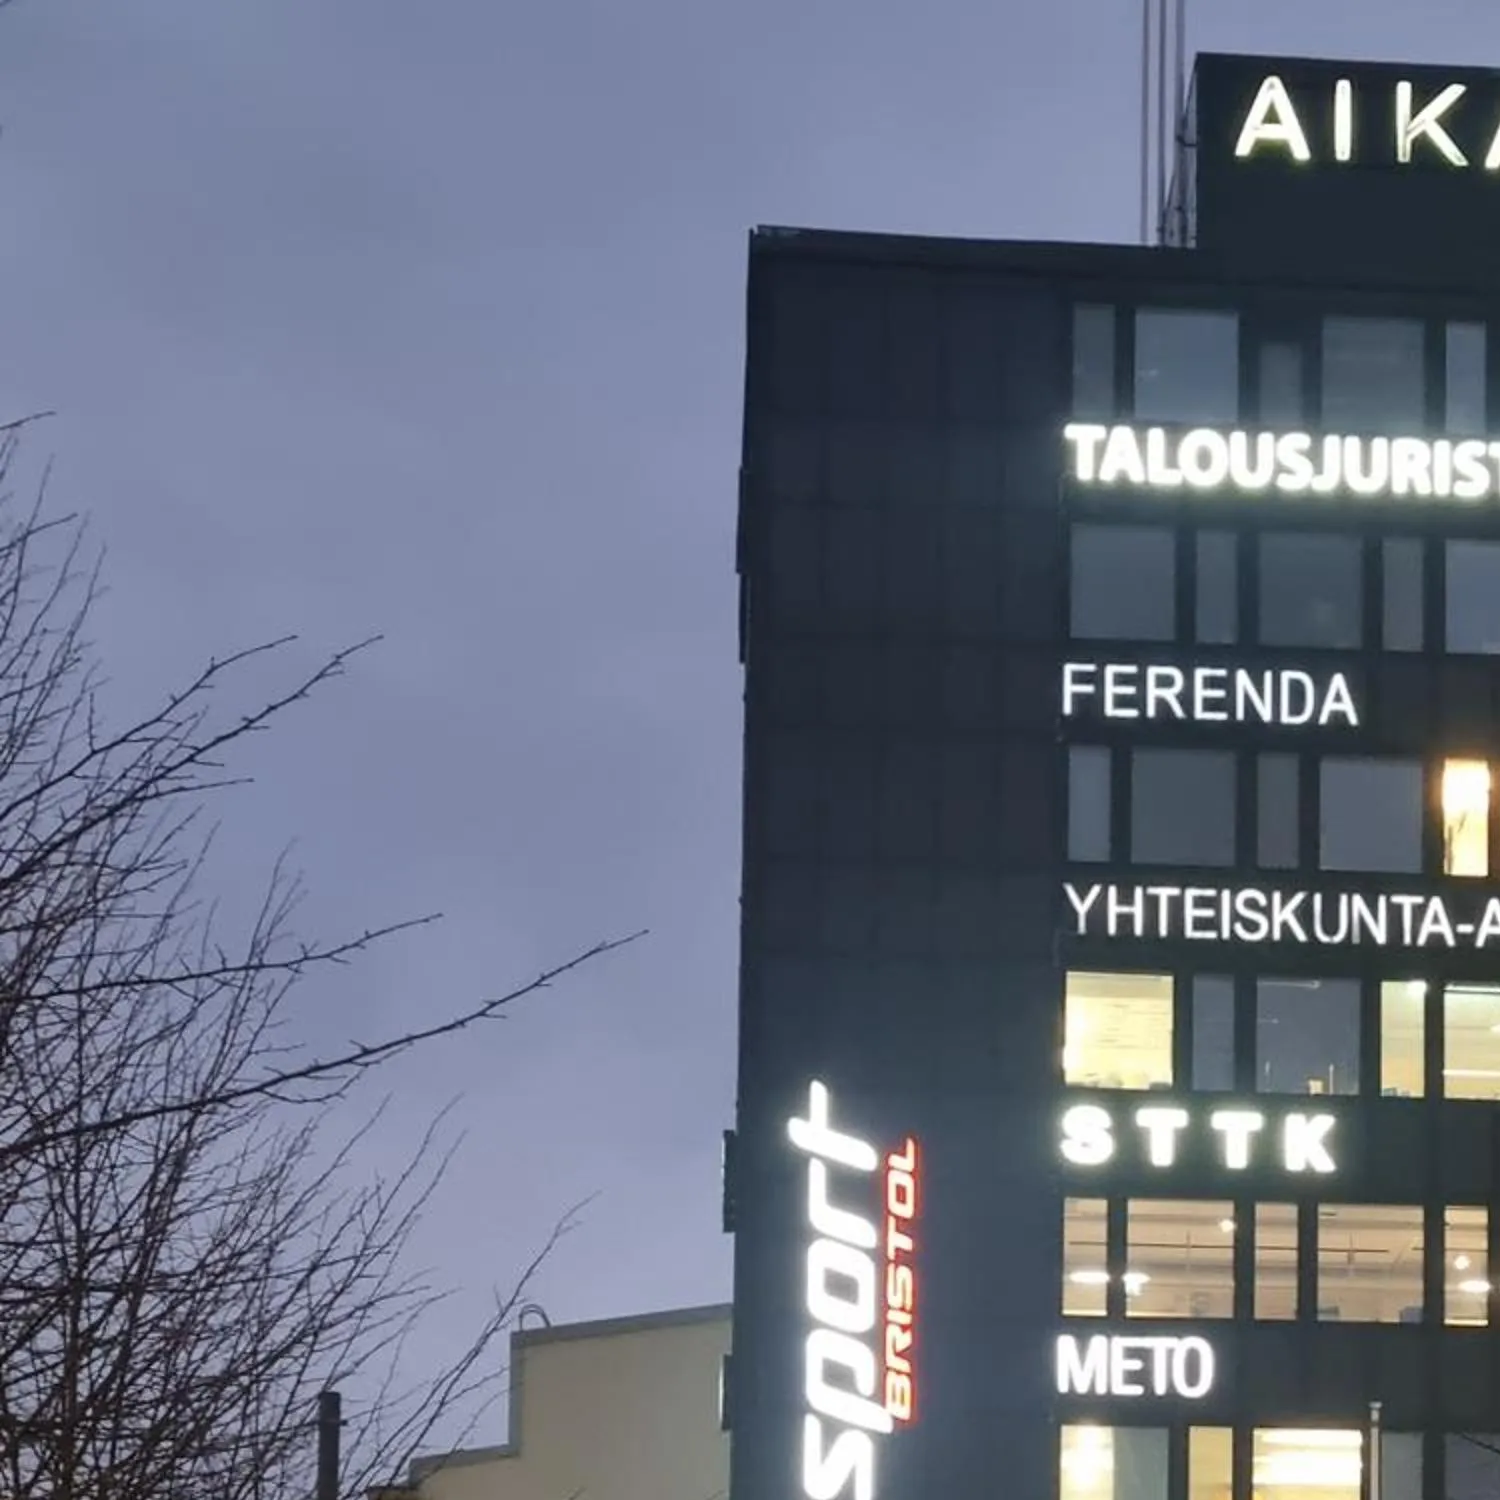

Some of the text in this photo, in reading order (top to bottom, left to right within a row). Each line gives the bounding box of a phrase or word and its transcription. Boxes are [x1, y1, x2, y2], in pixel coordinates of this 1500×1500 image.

[1061, 662, 1359, 727] FERENDA
[1059, 1105, 1336, 1173] STTK
[886, 1136, 917, 1423] BRISTOL
[1055, 1335, 1215, 1398] METO
